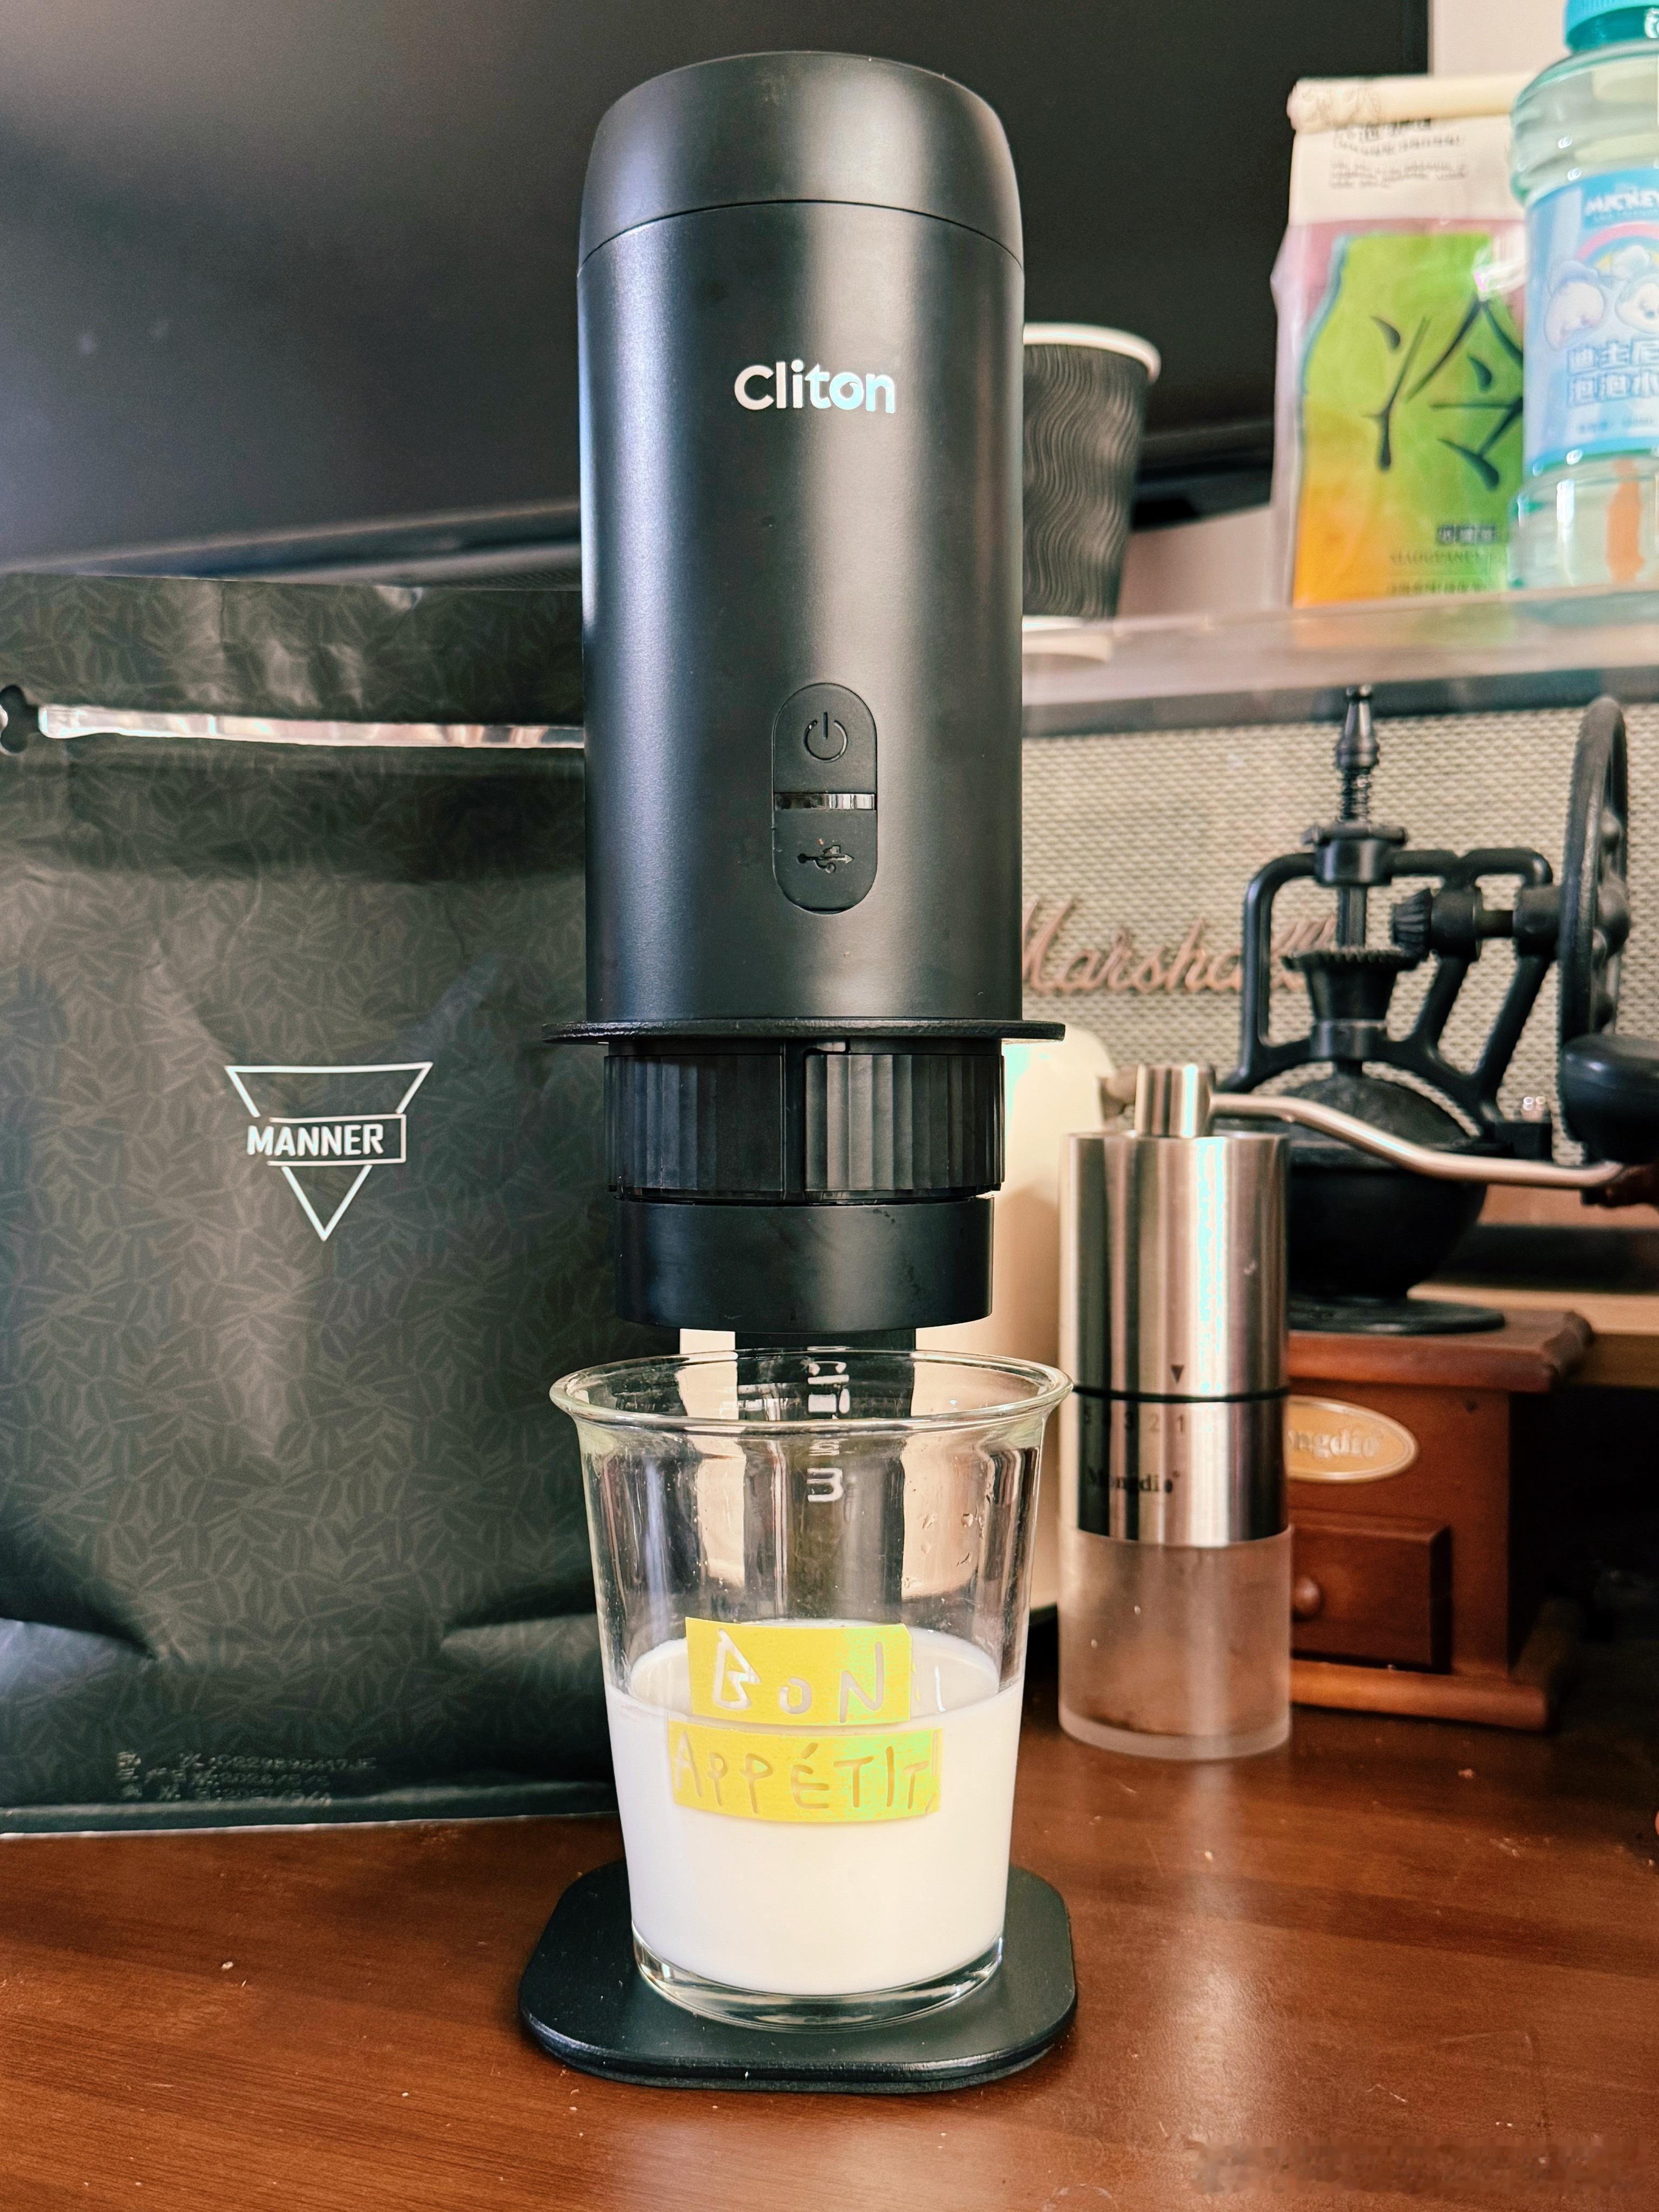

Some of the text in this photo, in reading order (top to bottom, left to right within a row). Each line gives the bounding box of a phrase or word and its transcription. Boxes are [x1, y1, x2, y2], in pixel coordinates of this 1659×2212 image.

[734, 359, 896, 414] Cliton
[246, 1124, 384, 1156] MANNER
[1148, 1412, 1161, 1433] 2
[1177, 1413, 1186, 1433] 1
[1287, 1426, 1382, 1460] ngdio
